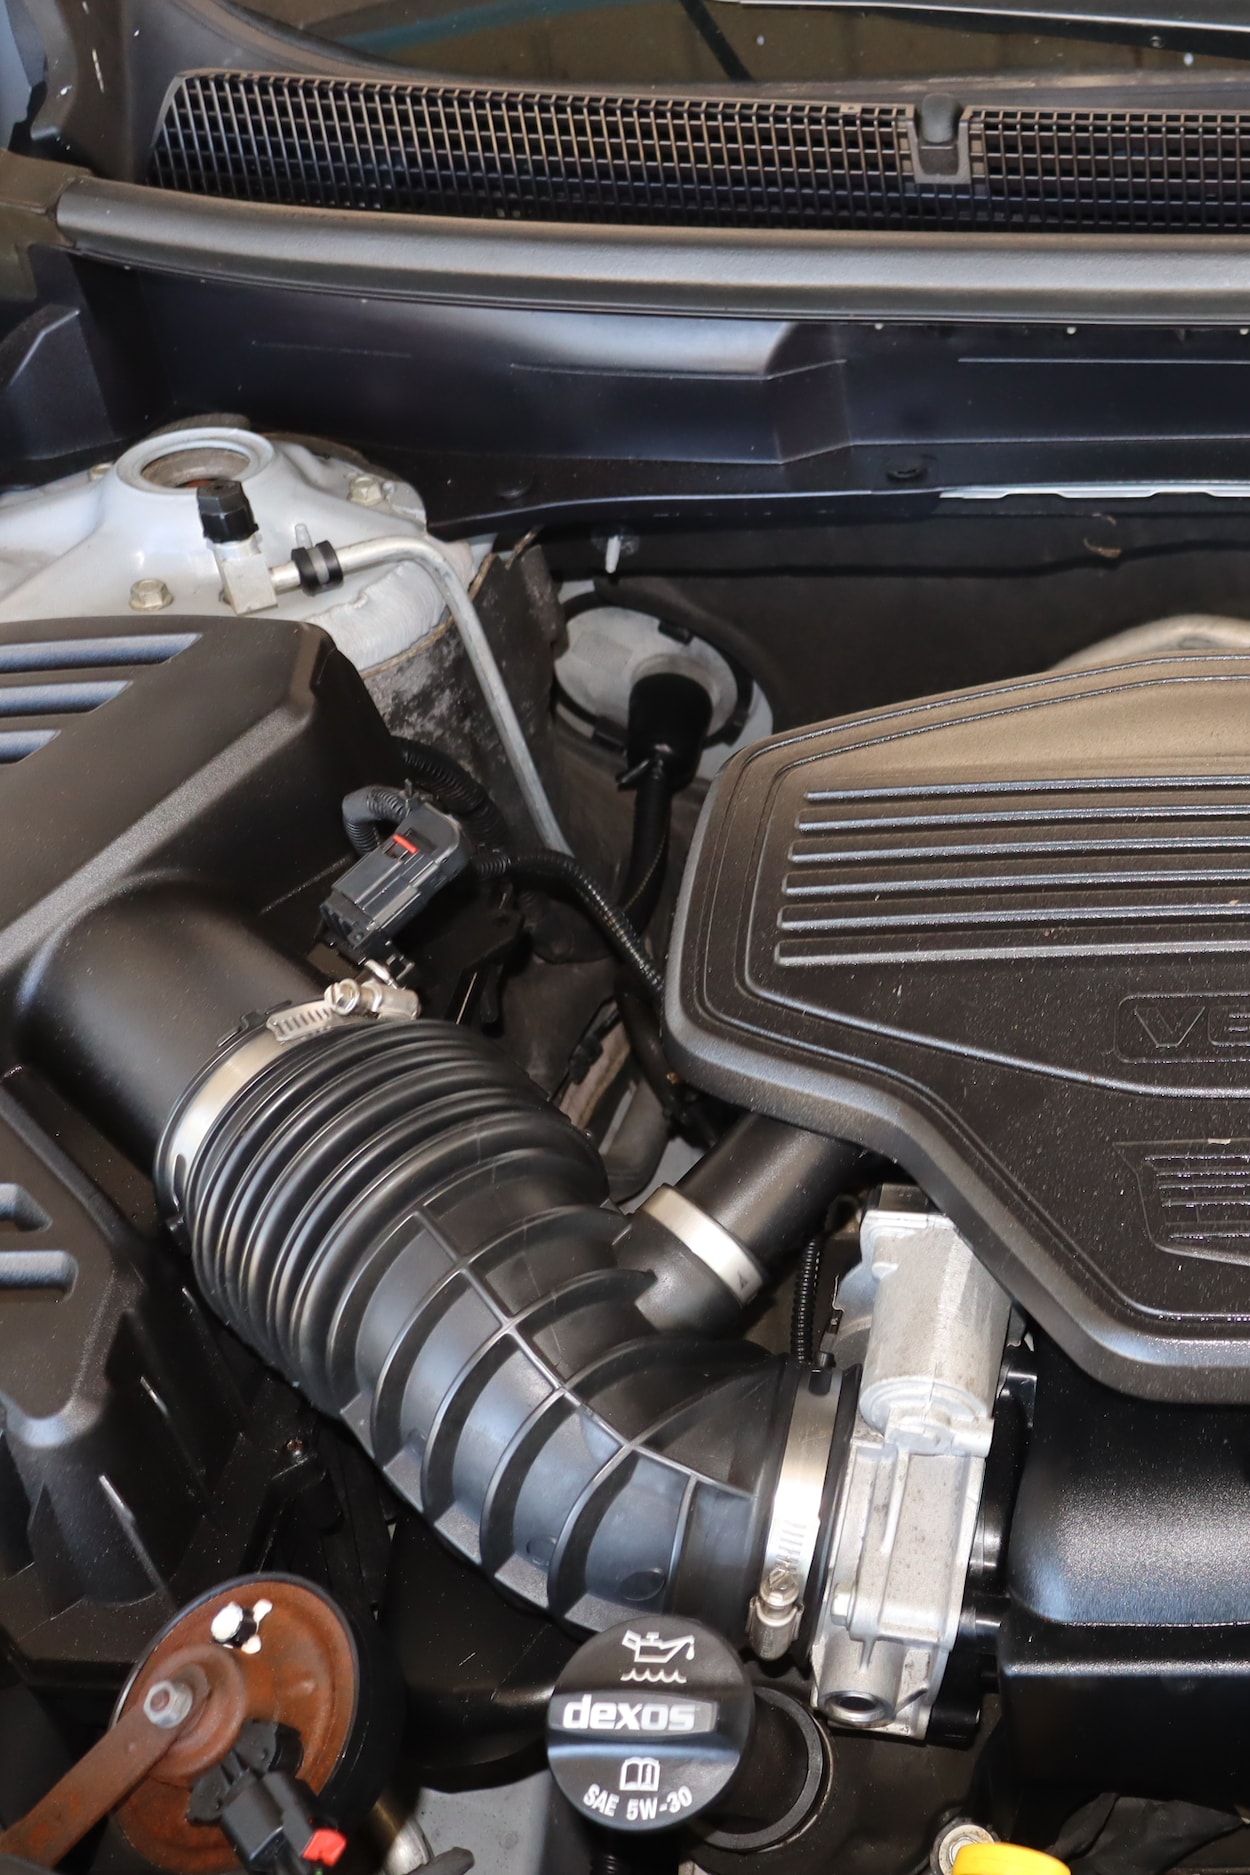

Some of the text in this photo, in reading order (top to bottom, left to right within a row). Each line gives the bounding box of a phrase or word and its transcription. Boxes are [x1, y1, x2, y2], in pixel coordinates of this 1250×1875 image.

[562, 1693, 697, 1731] dexos
[583, 1783, 693, 1821] SAE 5W-30
